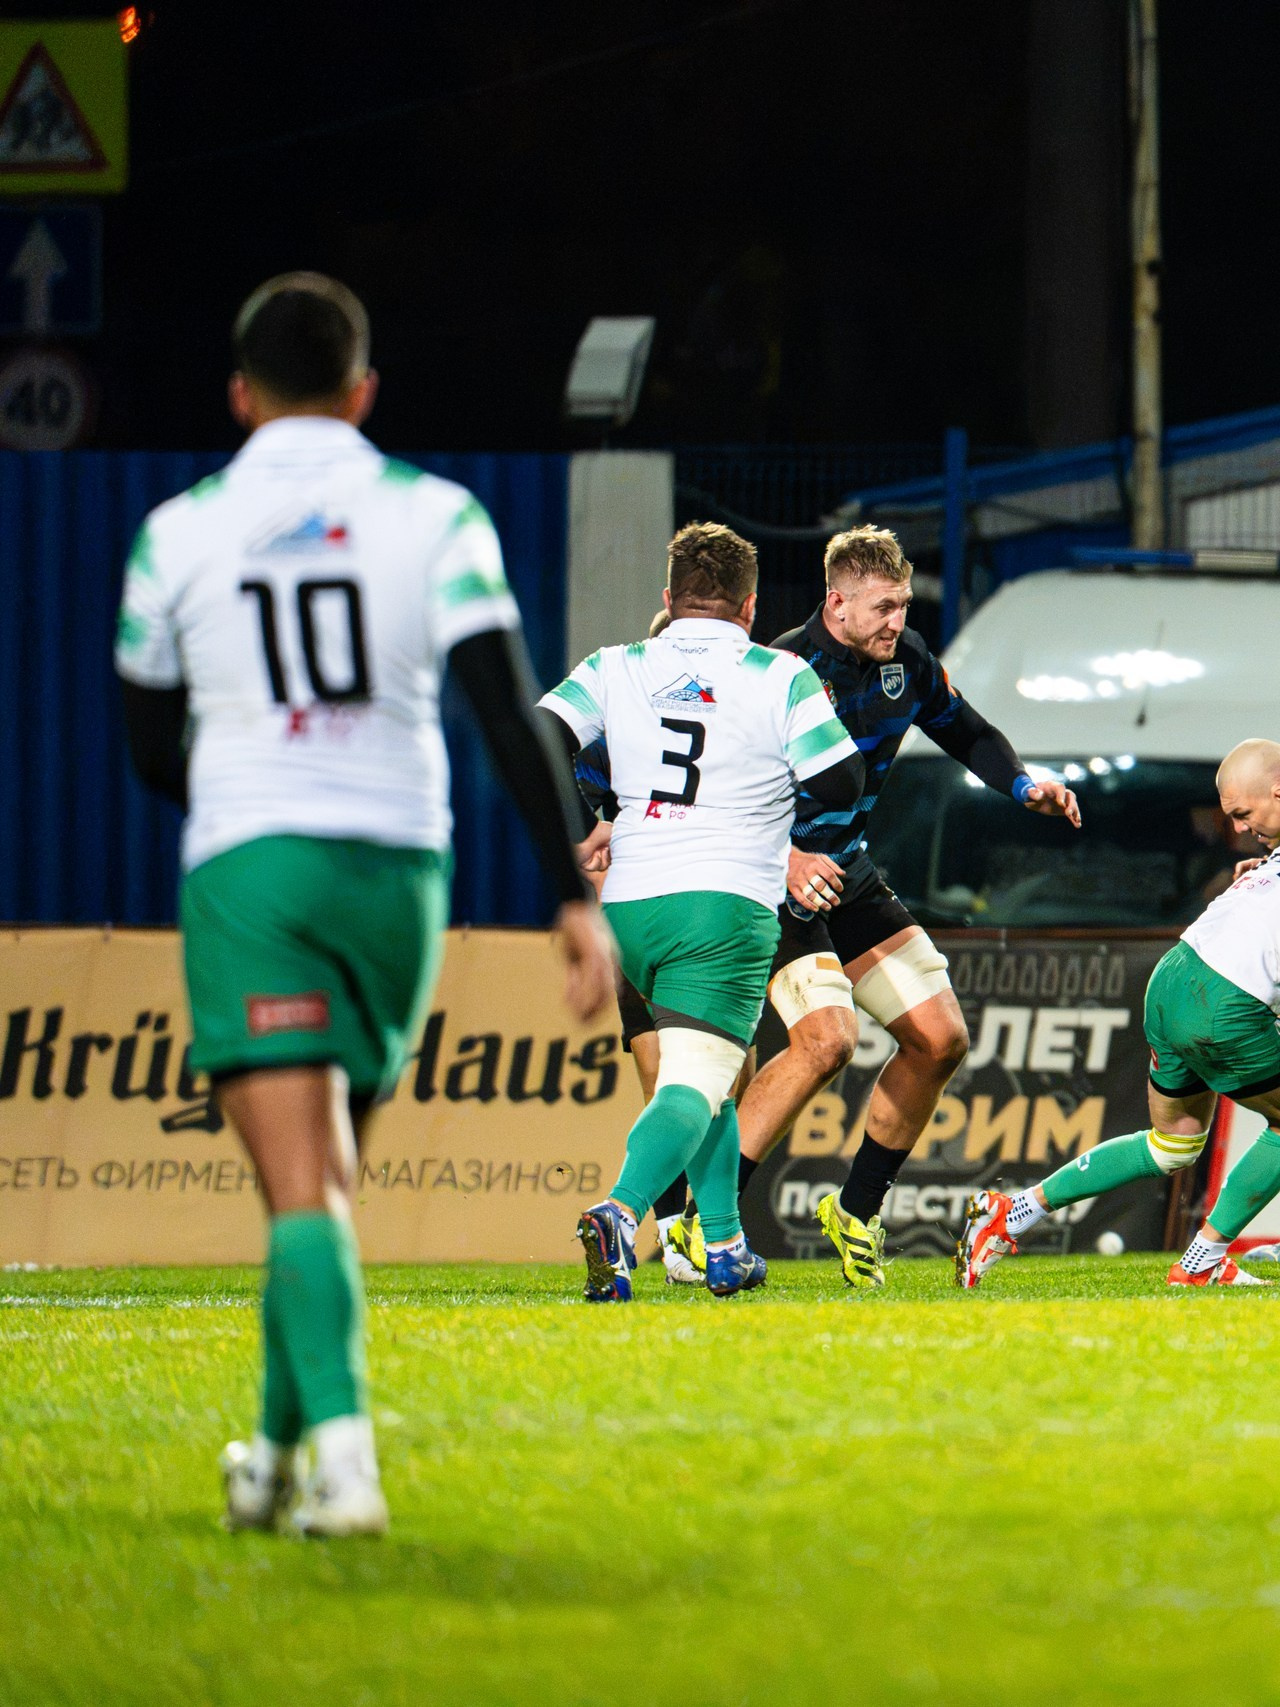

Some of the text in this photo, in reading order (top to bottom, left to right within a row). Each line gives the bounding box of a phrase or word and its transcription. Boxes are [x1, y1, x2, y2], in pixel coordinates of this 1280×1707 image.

[7, 374, 71, 430] 40
[239, 578, 373, 705] 10
[650, 717, 706, 805] 3
[0, 1006, 224, 1134] Krüg
[966, 1005, 1131, 1073] ЛЕТ
[788, 1091, 1106, 1163] ВРИМ
[92, 1157, 265, 1192] ФИРМЕН
[359, 1157, 602, 1195] МАГАЗИНОВ
